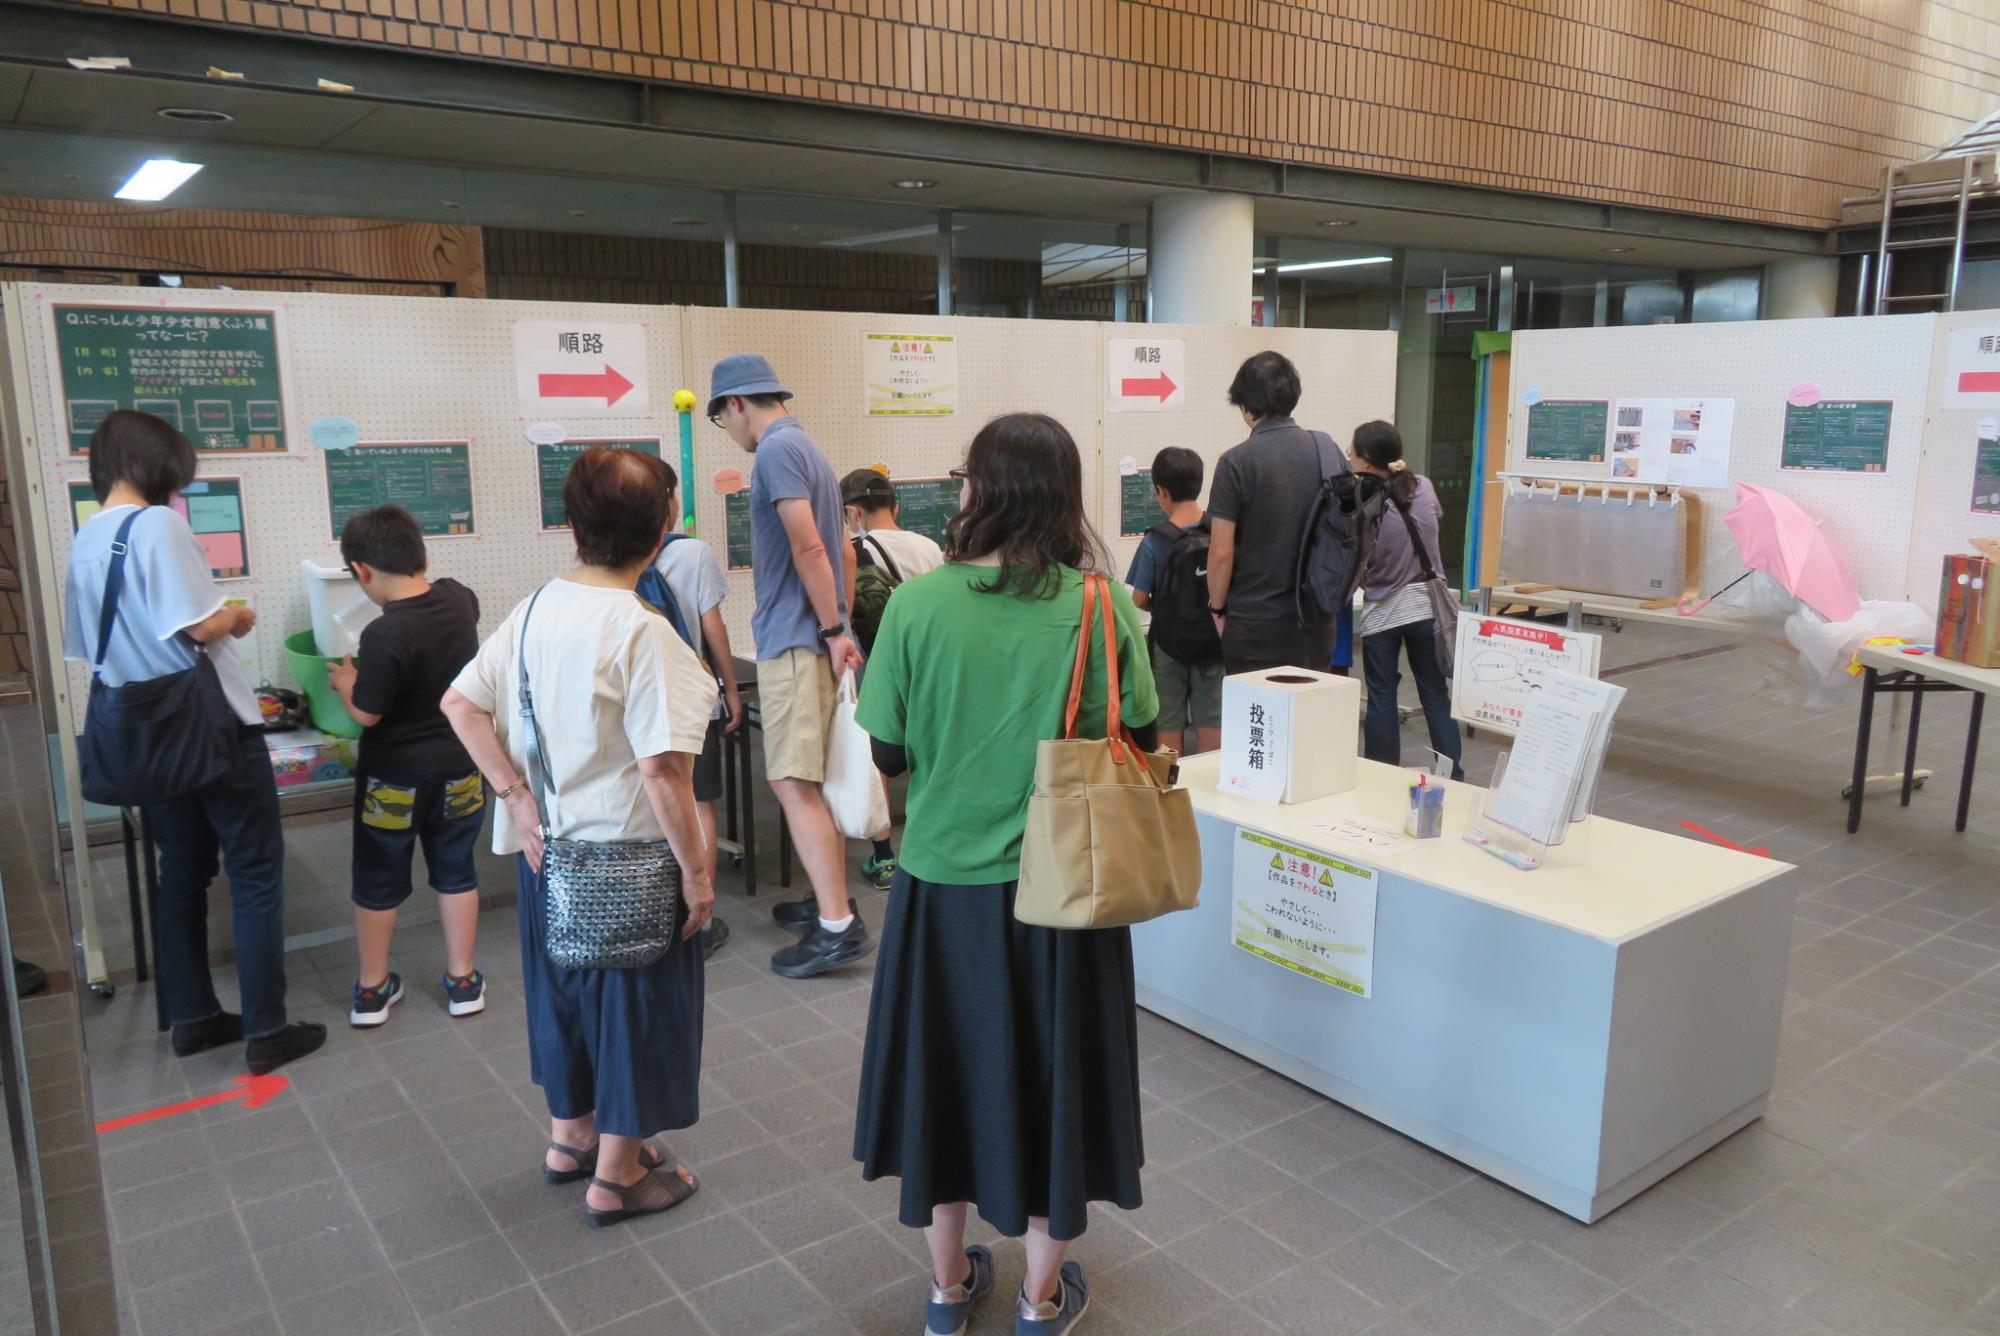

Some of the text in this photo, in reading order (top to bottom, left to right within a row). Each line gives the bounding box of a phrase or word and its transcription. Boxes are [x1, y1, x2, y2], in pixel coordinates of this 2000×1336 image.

[558, 332, 605, 354] 順路
[1135, 346, 1161, 363] 順路
[1248, 702, 1265, 771] 投票箱
[1287, 857, 1316, 880] 注意!
[1267, 869, 1337, 902] 【作品をさわるとき】
[1266, 926, 1331, 959] お願いいたします。
